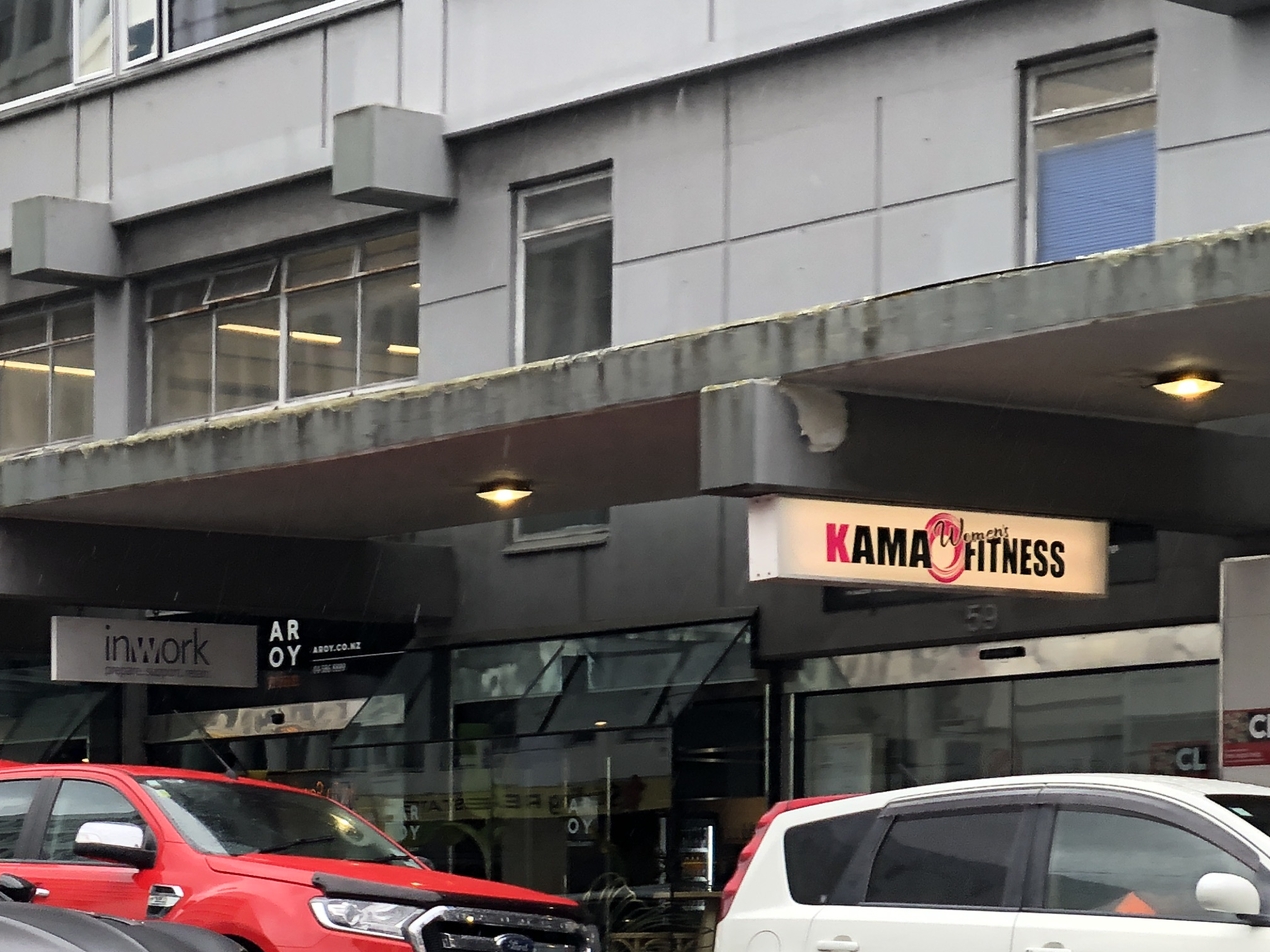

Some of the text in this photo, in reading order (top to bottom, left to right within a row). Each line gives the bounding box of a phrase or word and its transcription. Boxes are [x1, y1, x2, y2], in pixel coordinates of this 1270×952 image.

[933, 517, 1009, 548] Women's
[826, 522, 1065, 578] KAMA FITNESS
[268, 619, 300, 642] AR
[104, 624, 211, 666] inwork
[268, 645, 302, 668] OY
[312, 641, 362, 654] AROY.CO.NZ
